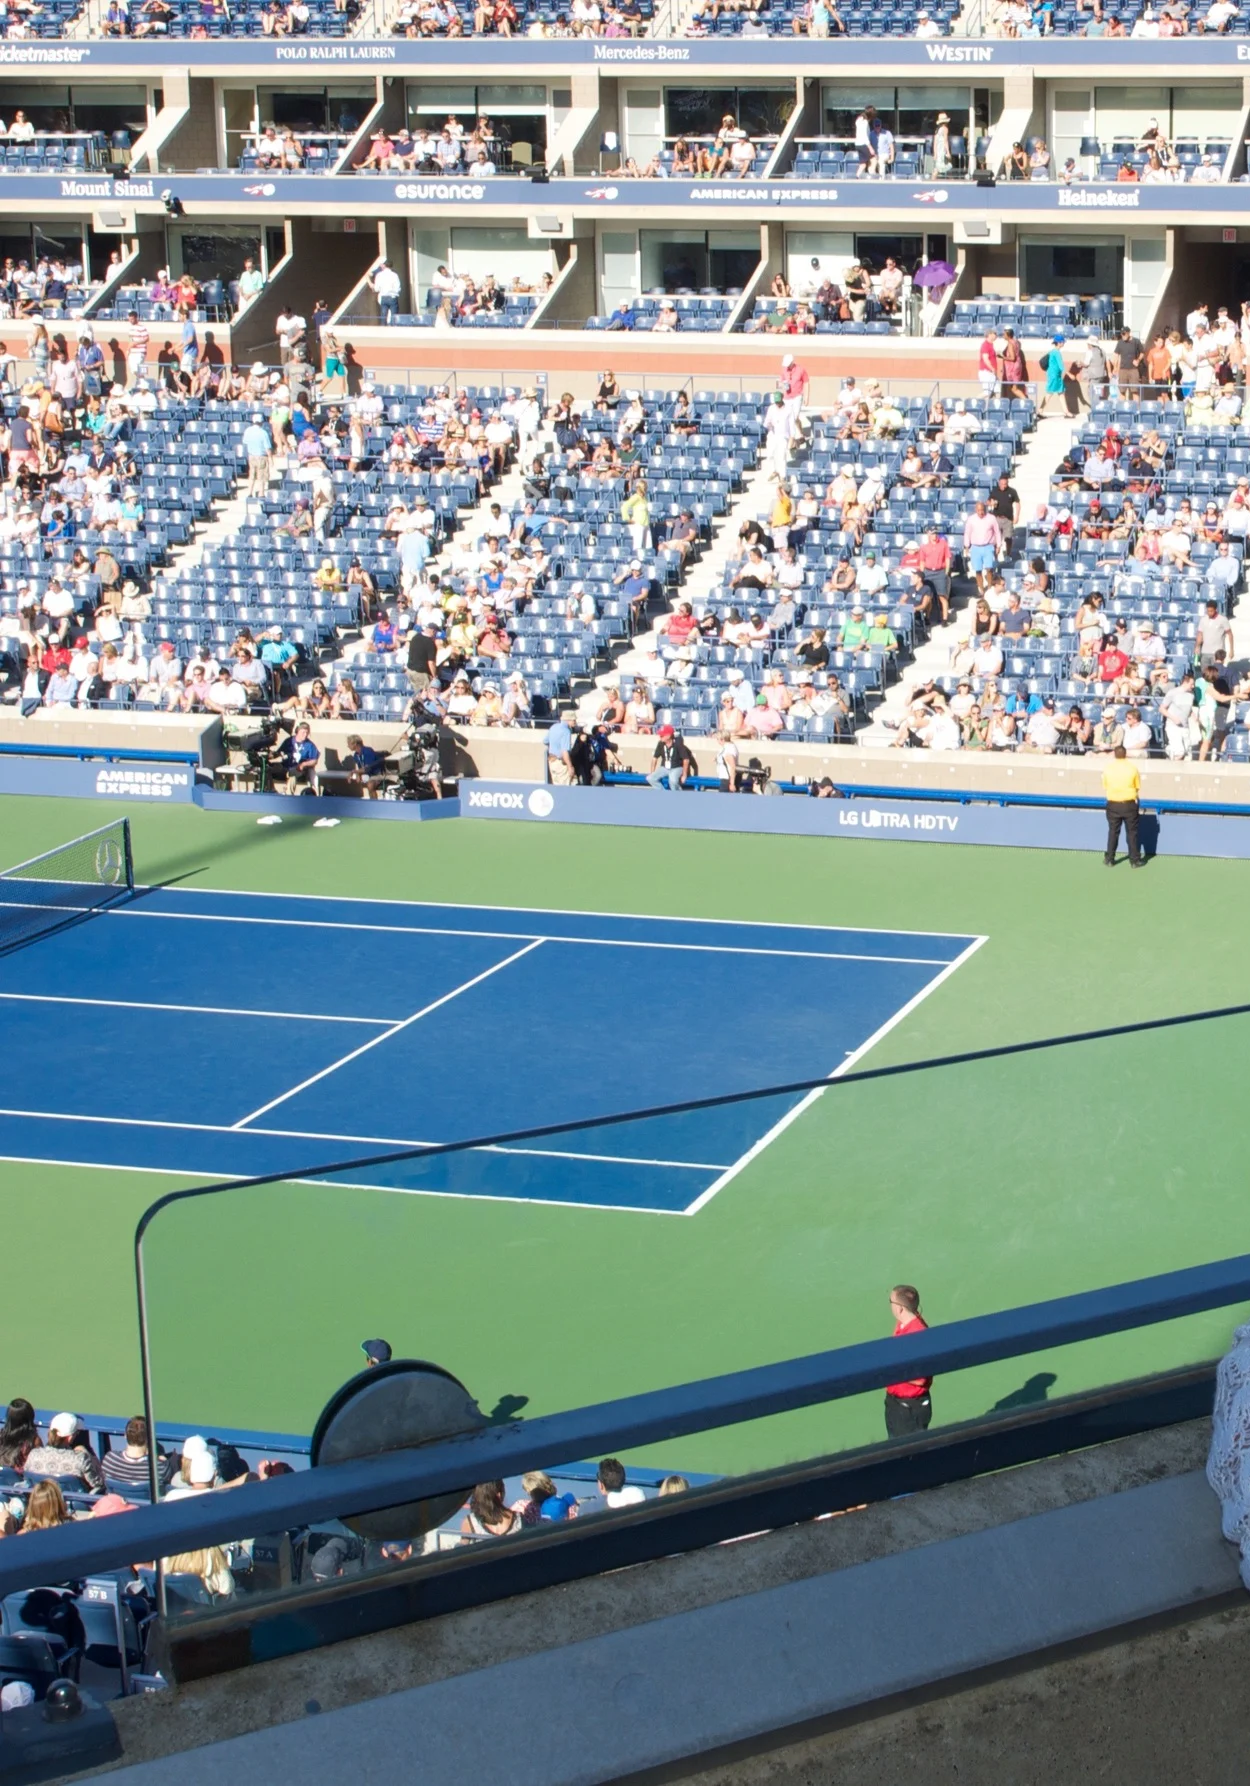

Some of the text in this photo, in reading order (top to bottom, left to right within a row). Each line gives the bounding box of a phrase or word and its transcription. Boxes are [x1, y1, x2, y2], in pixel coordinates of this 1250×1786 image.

[276, 47, 396, 59] POLO RALPH LAUREN
[594, 45, 690, 60] Mercedes-Benz
[926, 44, 992, 62] WESTIN
[61, 180, 154, 196] Mount Sinai
[395, 184, 483, 200] esurance
[690, 189, 838, 200] AMERICAN EXPRESS
[1058, 189, 1140, 207] Heineken
[97, 770, 188, 786] AMERICAN
[96, 782, 172, 797] EXPRESS
[469, 791, 524, 809] xerox
[839, 809, 958, 832] LG UTRA HDTV
[88, 1589, 107, 1600] 57 B
